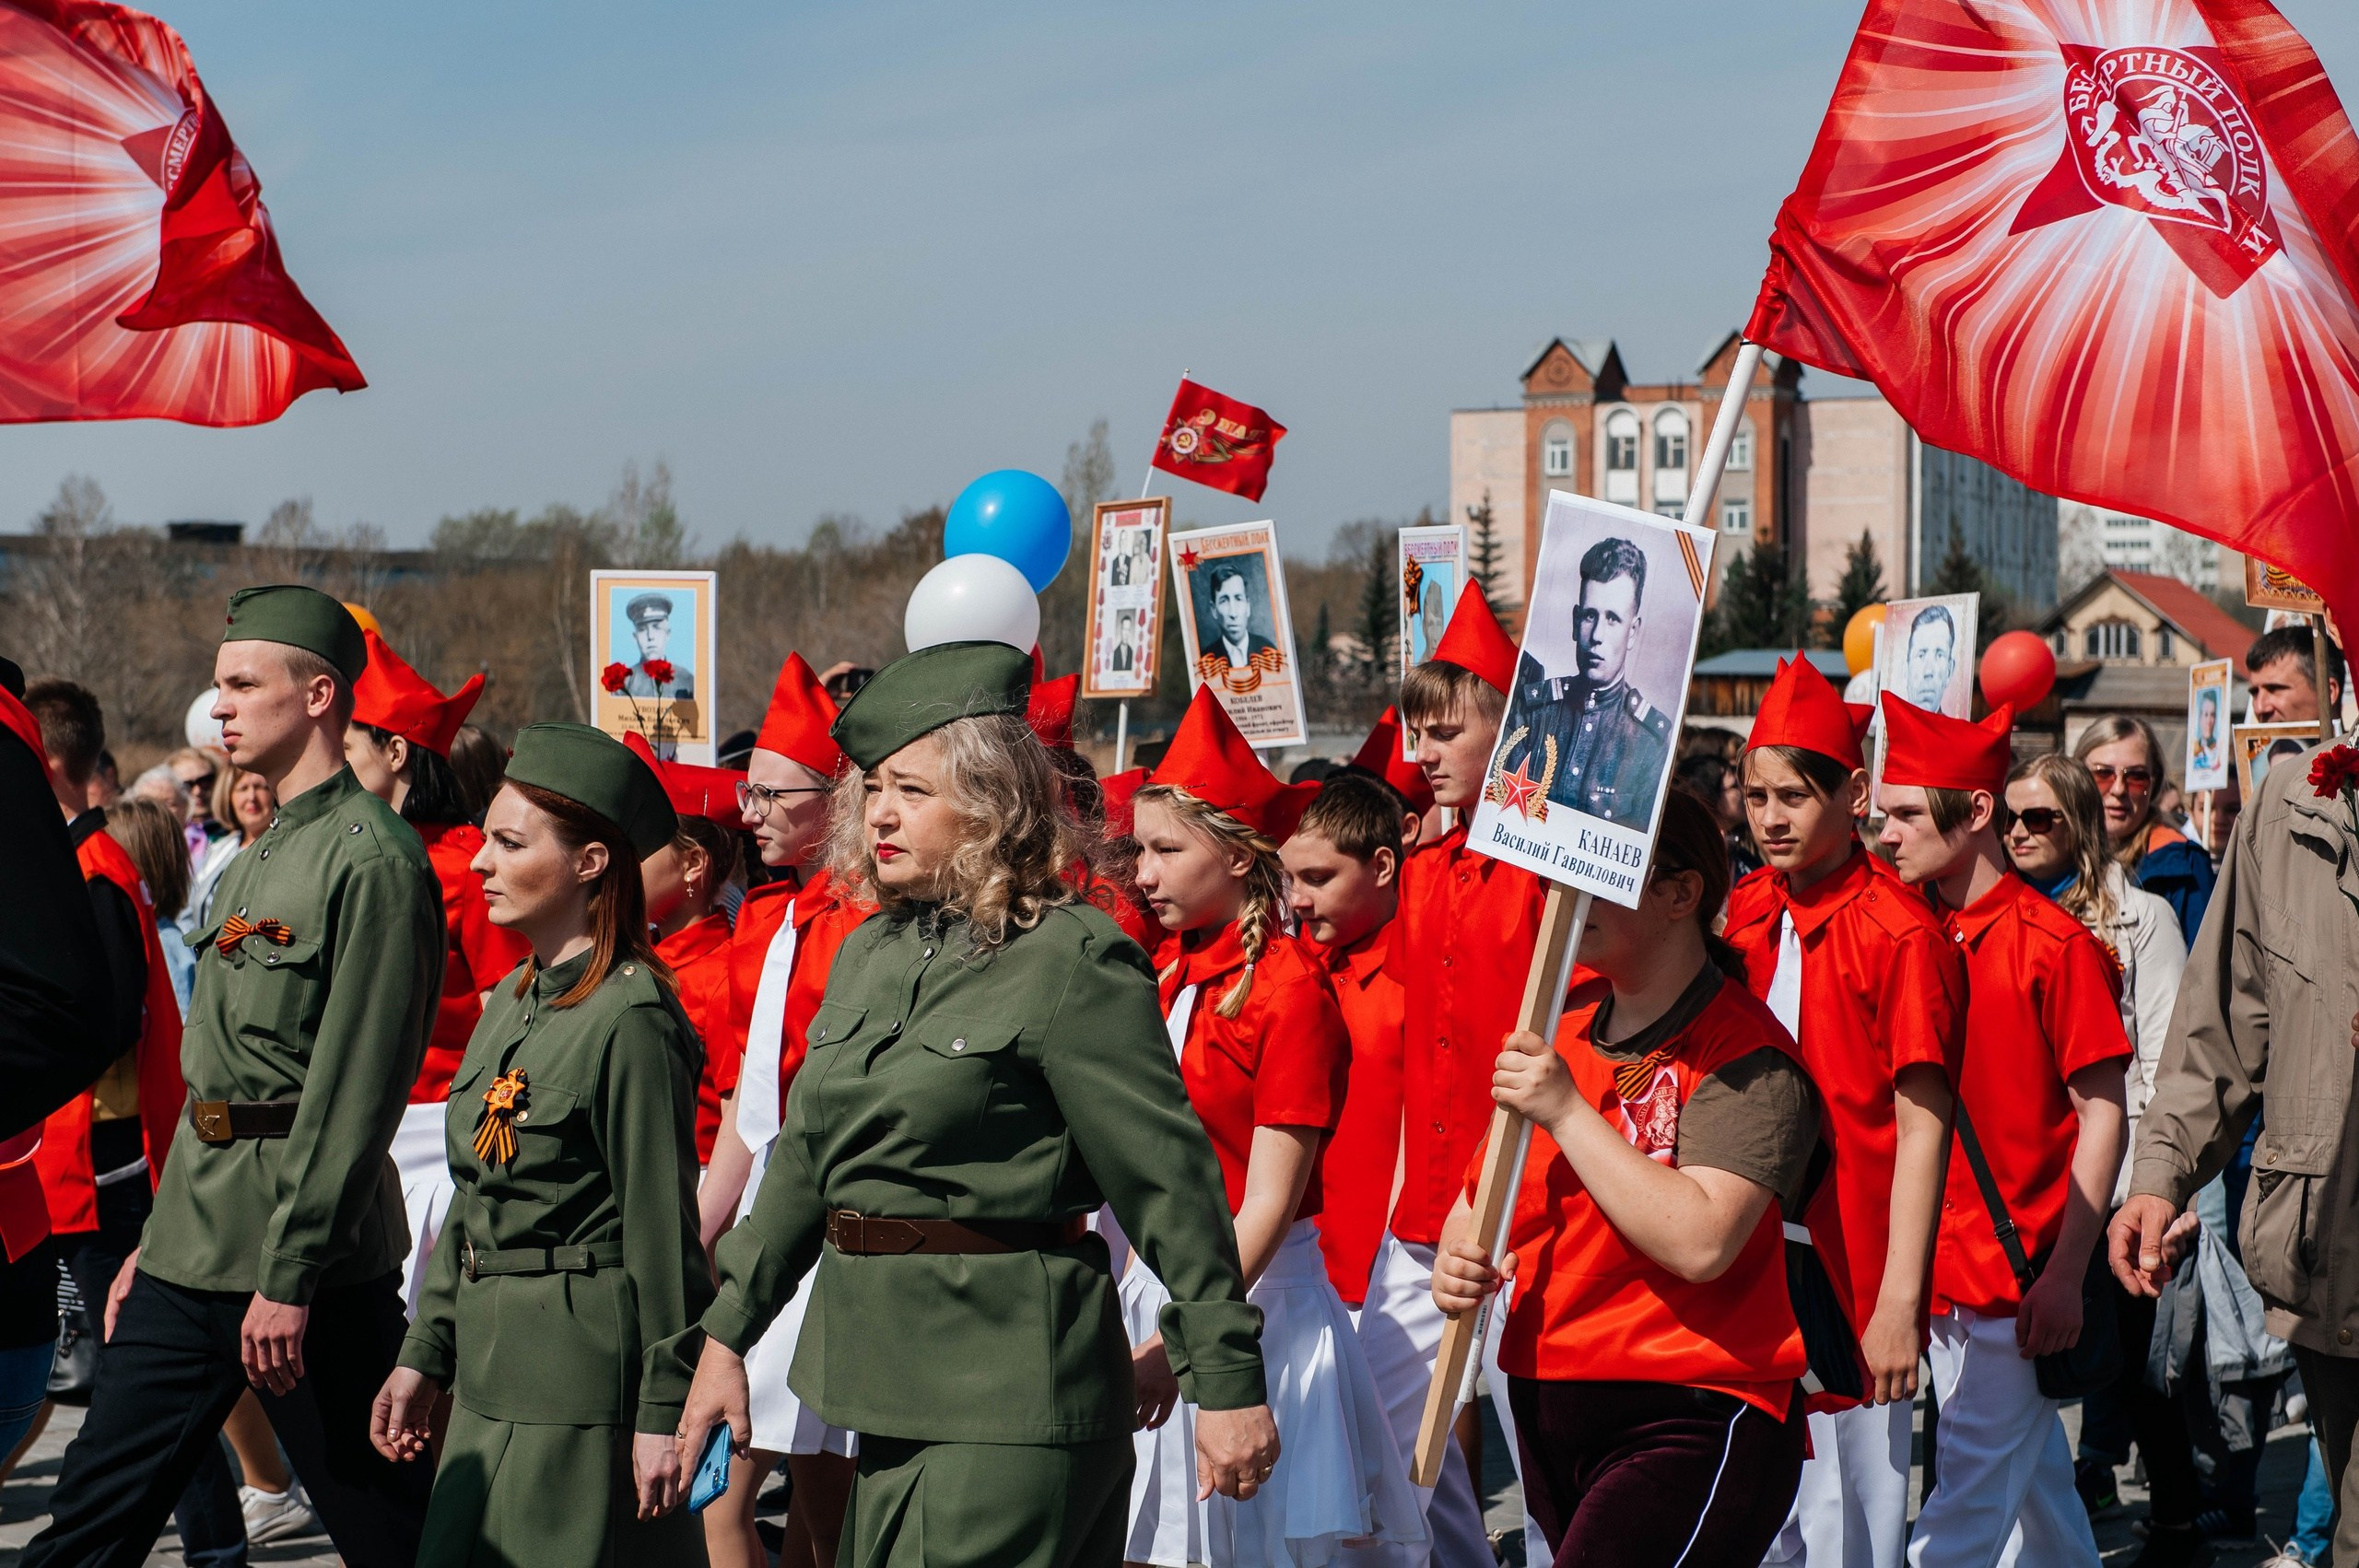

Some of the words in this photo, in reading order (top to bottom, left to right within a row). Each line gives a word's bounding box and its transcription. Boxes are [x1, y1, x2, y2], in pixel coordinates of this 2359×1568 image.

[2218, 106, 2261, 202] ПОЛК
[1492, 822, 1551, 861] Василий
[1551, 845, 1636, 893] Гаврилович
[1577, 828, 1642, 869] КАНАЕВ
